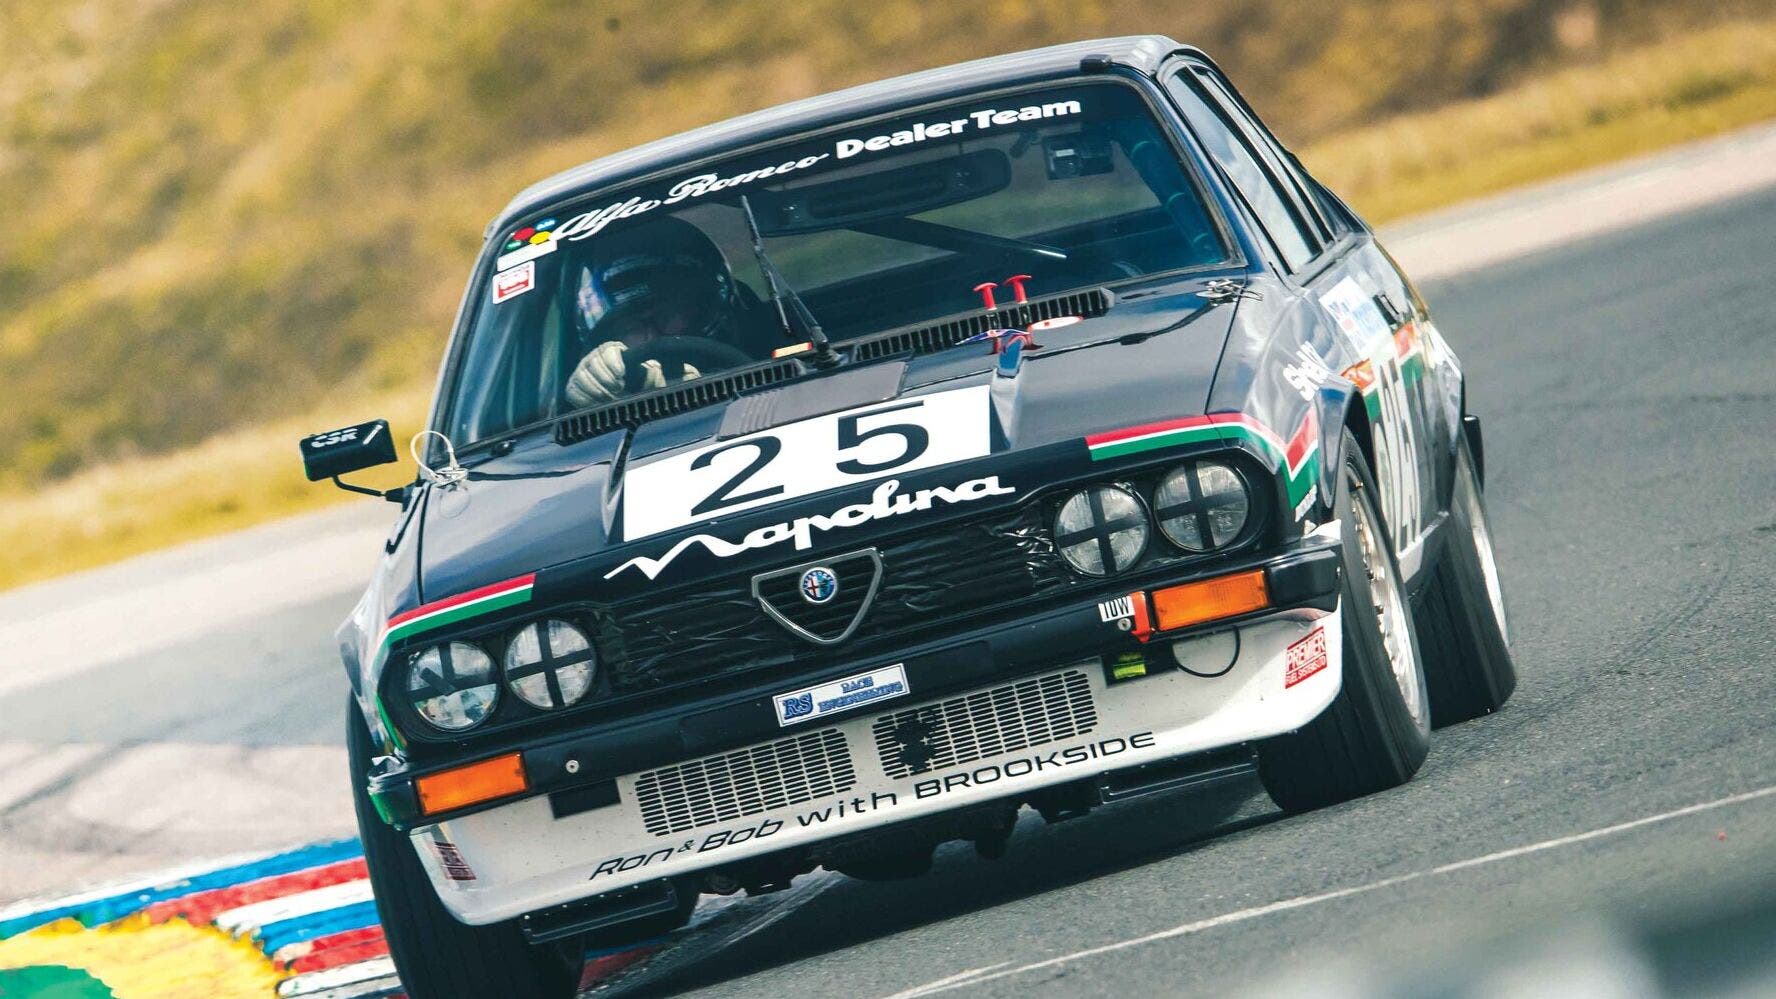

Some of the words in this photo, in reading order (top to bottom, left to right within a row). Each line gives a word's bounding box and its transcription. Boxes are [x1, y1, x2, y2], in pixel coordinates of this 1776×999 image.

[551, 196, 662, 242] Alfa
[663, 153, 830, 204] Romeo
[836, 117, 970, 160] Dealer
[970, 100, 1082, 130] Team
[689, 401, 930, 518] 25
[603, 476, 1016, 581] Napolina
[782, 692, 814, 720] RS
[589, 847, 674, 880] Ron
[697, 819, 784, 853] Bob
[796, 792, 897, 827] with
[915, 731, 1155, 796] BROOKSIDE
